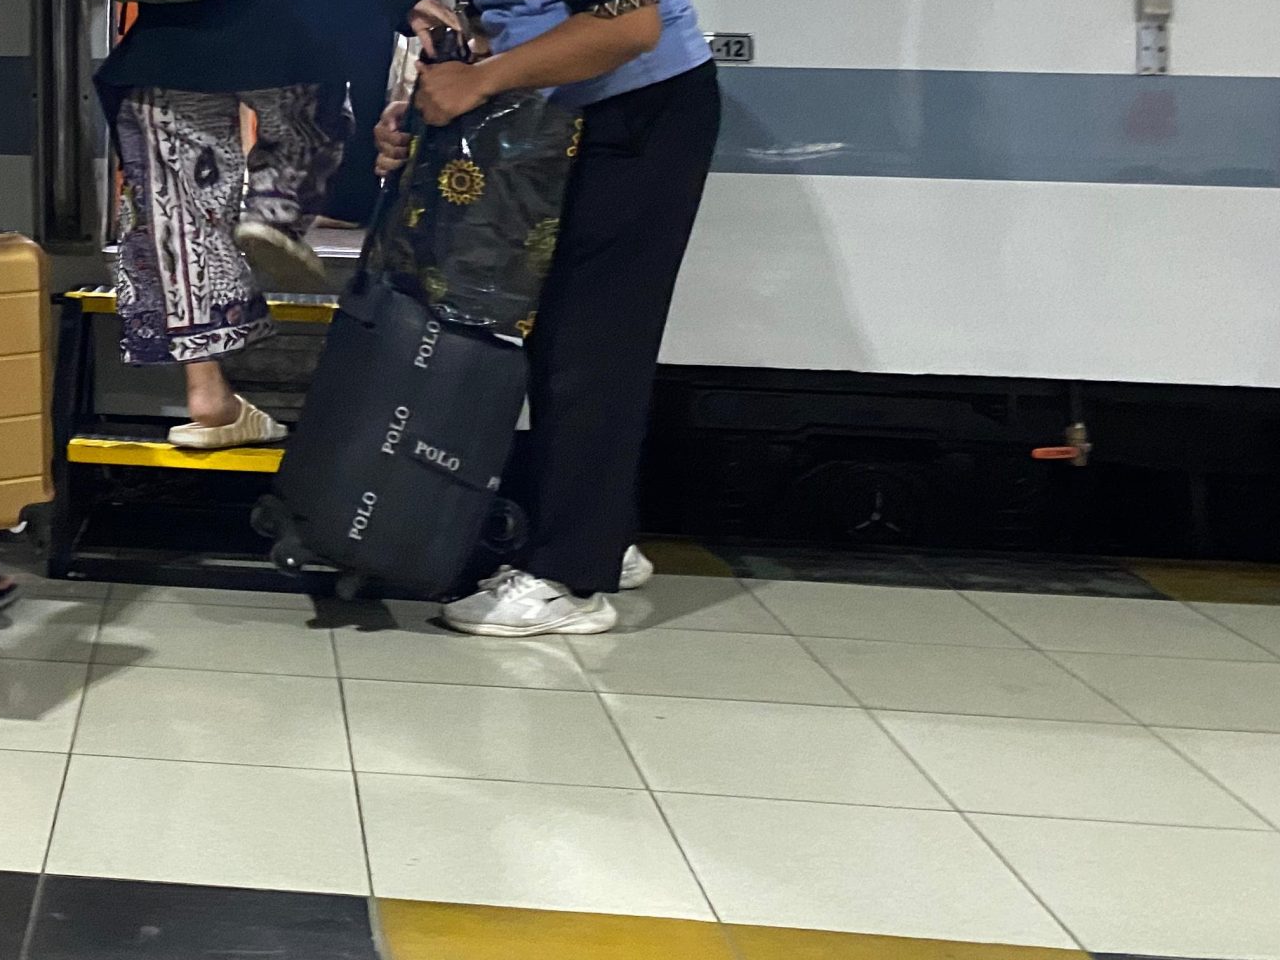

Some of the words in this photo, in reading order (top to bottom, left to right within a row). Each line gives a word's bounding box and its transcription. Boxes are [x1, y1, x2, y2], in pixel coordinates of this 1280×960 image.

[710, 39, 745, 58] -12
[414, 320, 442, 369] POLO
[381, 405, 410, 455] POLO
[413, 441, 461, 472] POLO
[348, 491, 378, 540] POLO
